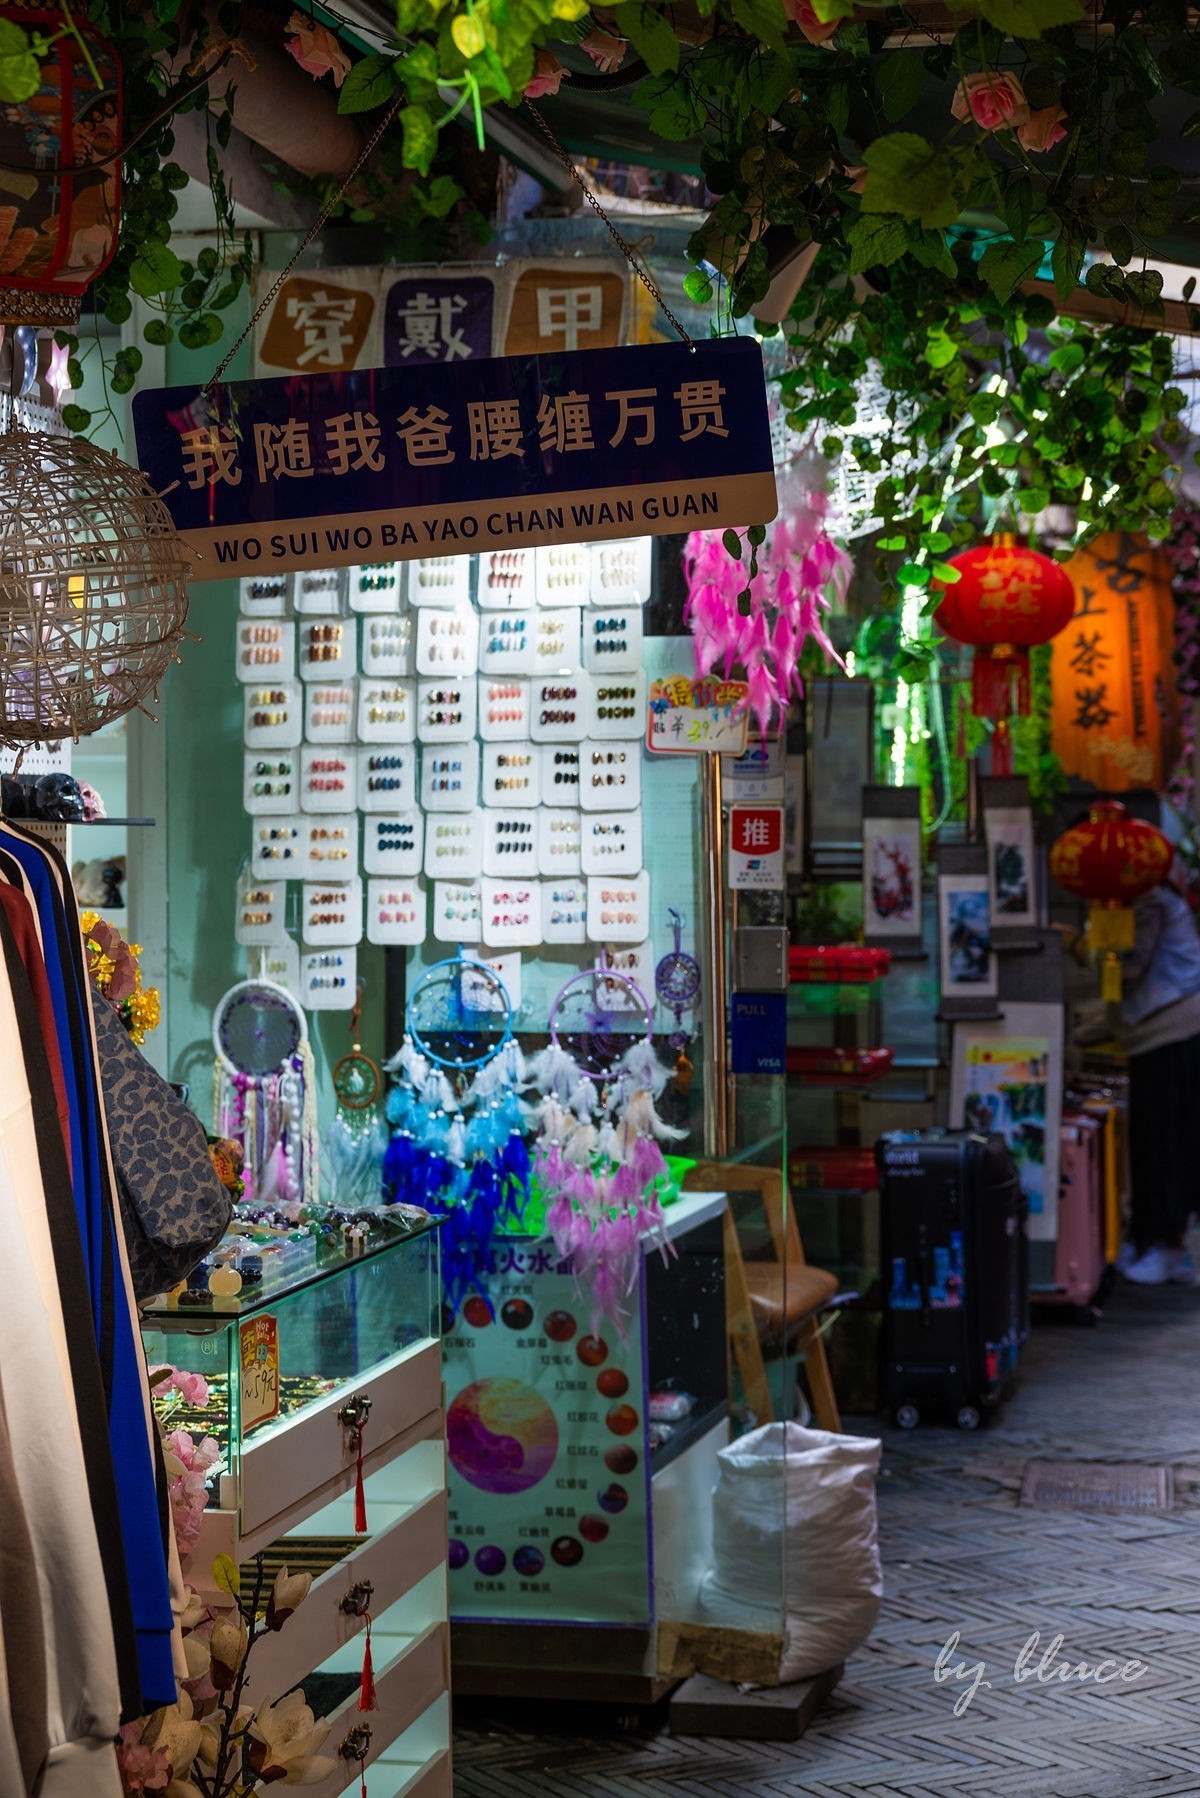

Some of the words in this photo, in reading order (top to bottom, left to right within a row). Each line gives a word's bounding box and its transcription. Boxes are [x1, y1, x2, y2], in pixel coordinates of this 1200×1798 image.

[286, 285, 602, 365] 穿戴甲
[180, 379, 730, 490] 我随我爸腰缠万贯
[214, 538, 262, 563] WO
[271, 532, 319, 557] SUI
[325, 527, 373, 552] WO
[381, 522, 418, 547] BA
[423, 516, 479, 542] YAO
[487, 507, 564, 536] CHAN
[571, 500, 634, 527] WAN
[642, 492, 719, 520] GUAN
[742, 817, 770, 847] 推
[737, 1003, 766, 1016] PULL
[757, 1057, 781, 1068] VISA
[256, 1319, 270, 1332] Hot
